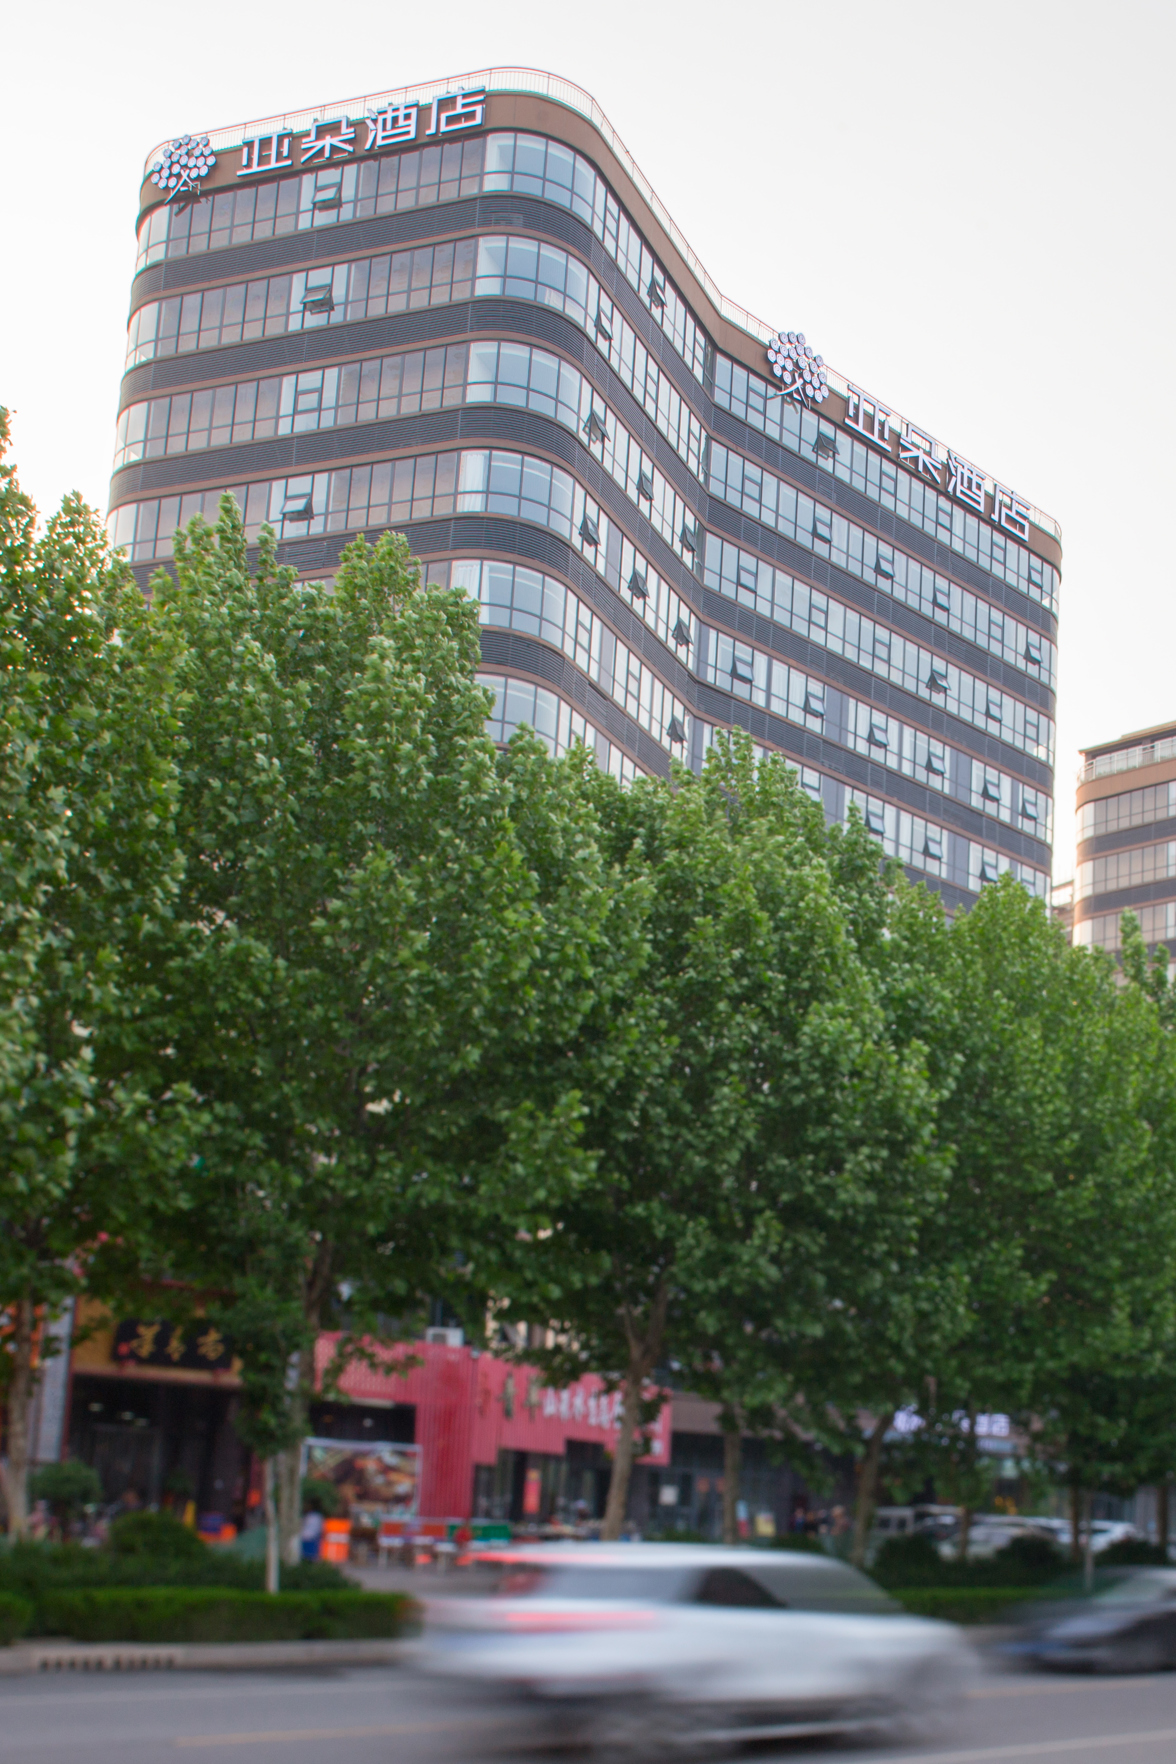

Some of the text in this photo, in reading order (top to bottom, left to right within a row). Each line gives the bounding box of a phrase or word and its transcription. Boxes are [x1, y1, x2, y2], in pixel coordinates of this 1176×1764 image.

[236, 87, 486, 177] 亚朵酒店
[844, 384, 1031, 542] 亚朵酒店
